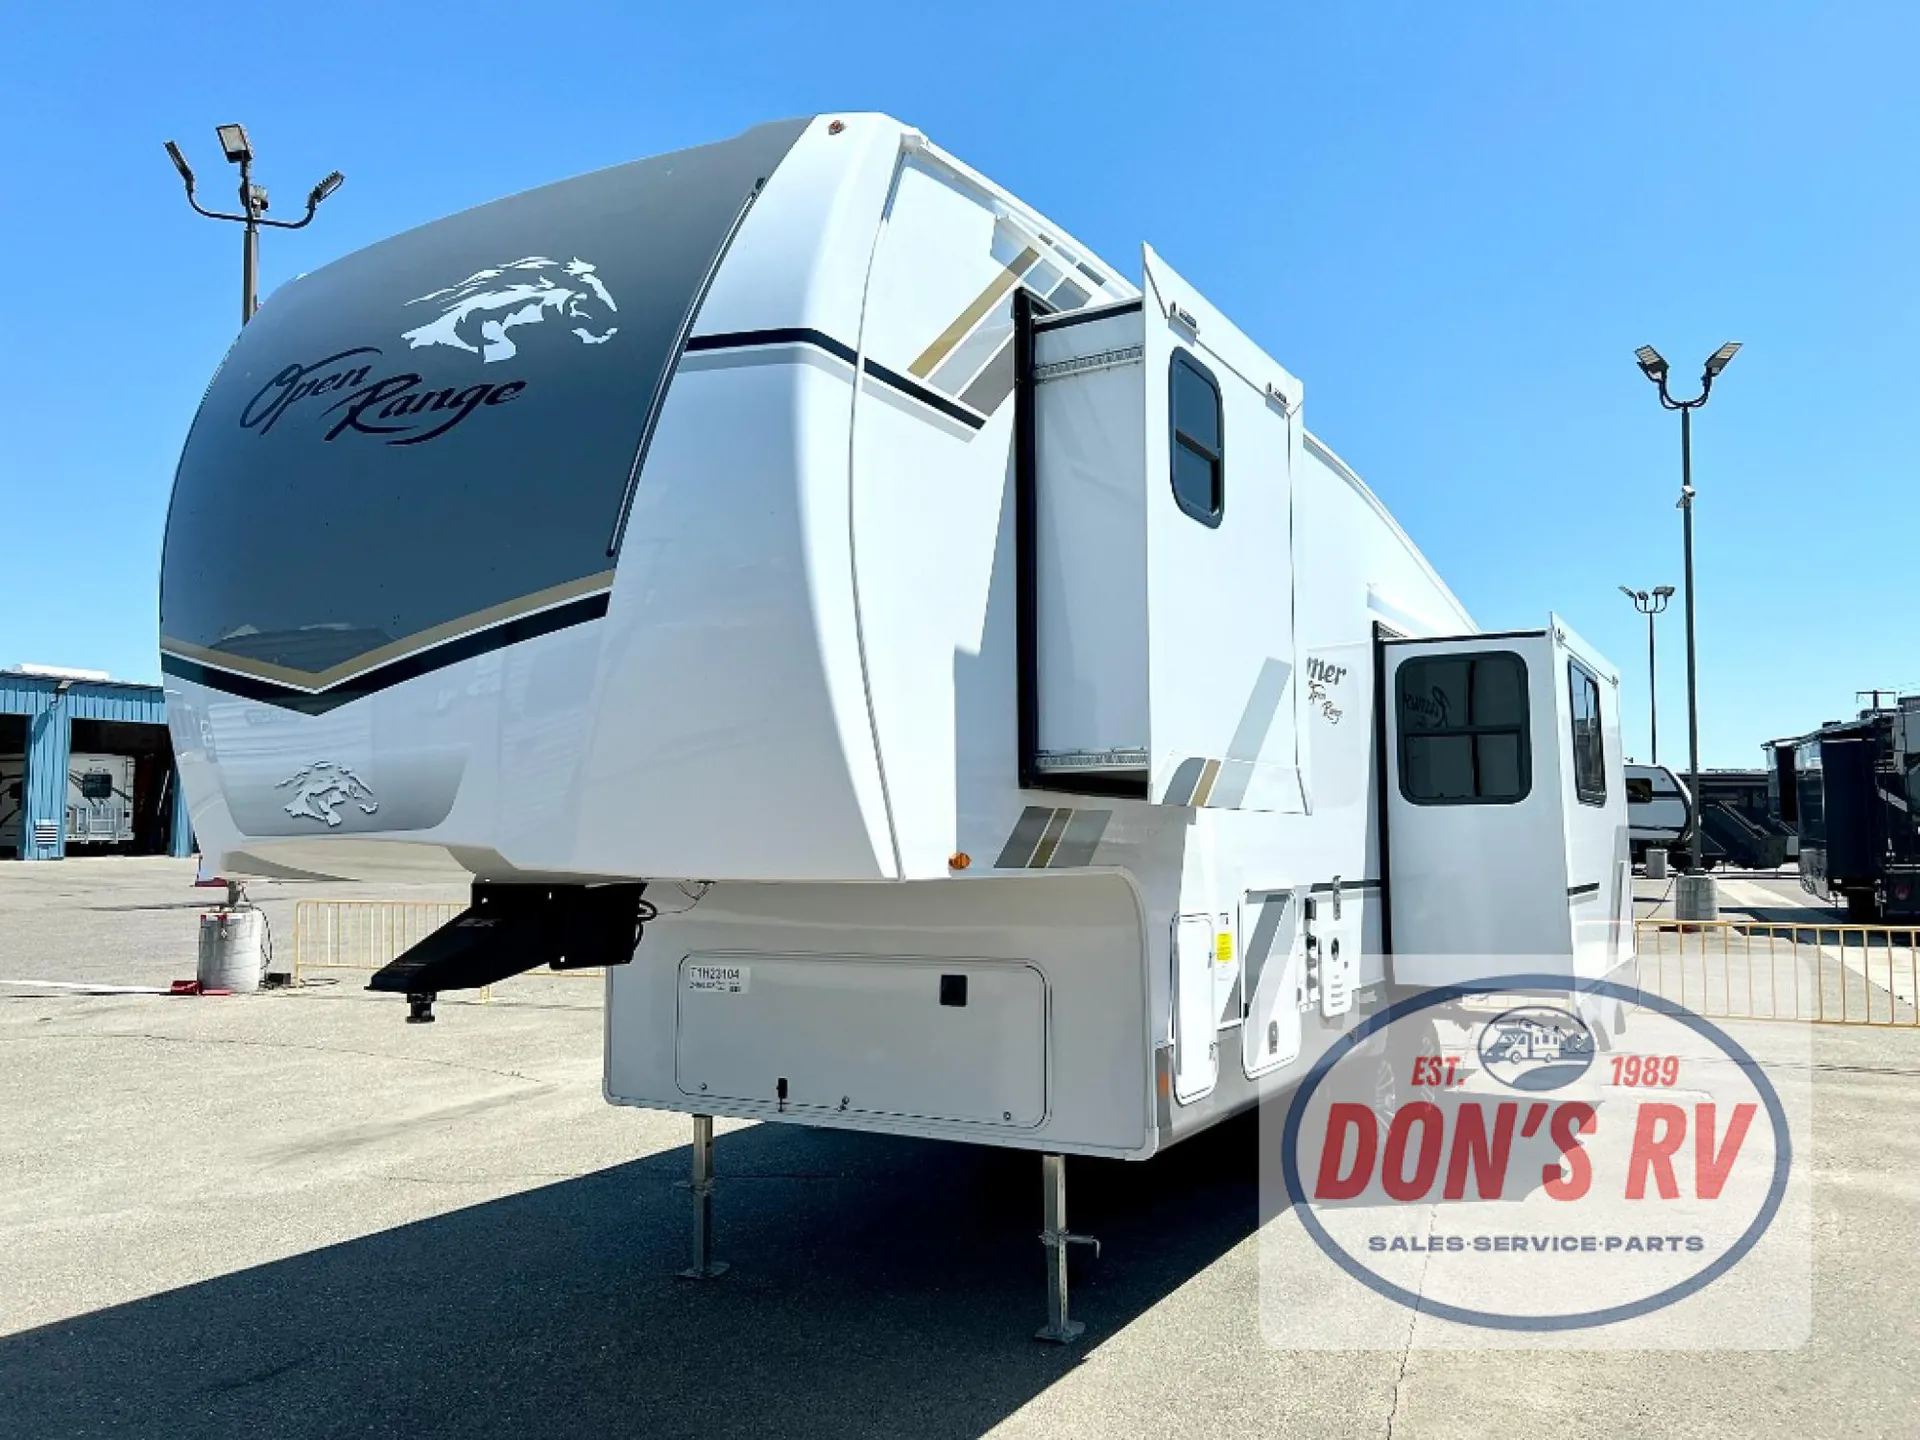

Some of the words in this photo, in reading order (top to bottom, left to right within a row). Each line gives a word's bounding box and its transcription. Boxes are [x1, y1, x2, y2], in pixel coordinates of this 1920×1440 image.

[239, 346, 383, 436] Open
[318, 373, 527, 445] Range
[1306, 656, 1347, 685] mer
